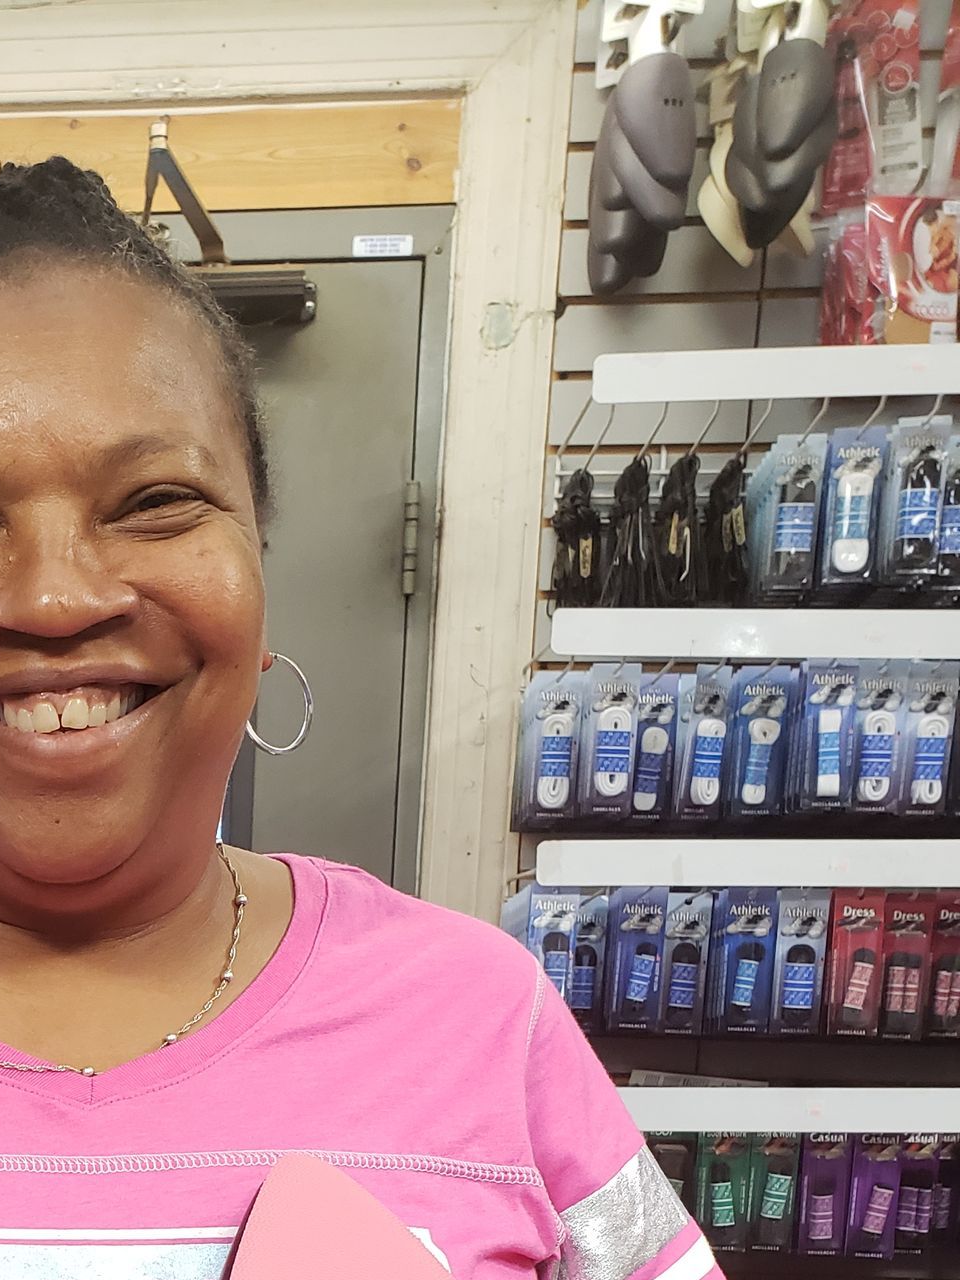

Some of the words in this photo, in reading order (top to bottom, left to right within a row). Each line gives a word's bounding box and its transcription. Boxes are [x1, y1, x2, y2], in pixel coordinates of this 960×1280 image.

[837, 446, 881, 458] Athletic
[812, 673, 855, 685] Athletic
[861, 679, 901, 690] Athletic
[598, 683, 634, 693] Athletic
[744, 684, 785, 696] Athletic
[540, 691, 577, 701] Athletic
[535, 900, 576, 912] Athletic
[623, 903, 663, 915] Athletic
[729, 904, 771, 916] Athletic
[576, 913, 602, 923] hletic
[671, 912, 705, 922] Athletic
[784, 907, 824, 918] Athletic
[843, 906, 876, 919] Dress
[893, 910, 925, 922] Dress
[940, 909, 960, 920] Dre
[809, 1132, 848, 1142] Casual
[861, 1134, 900, 1144] Casual
